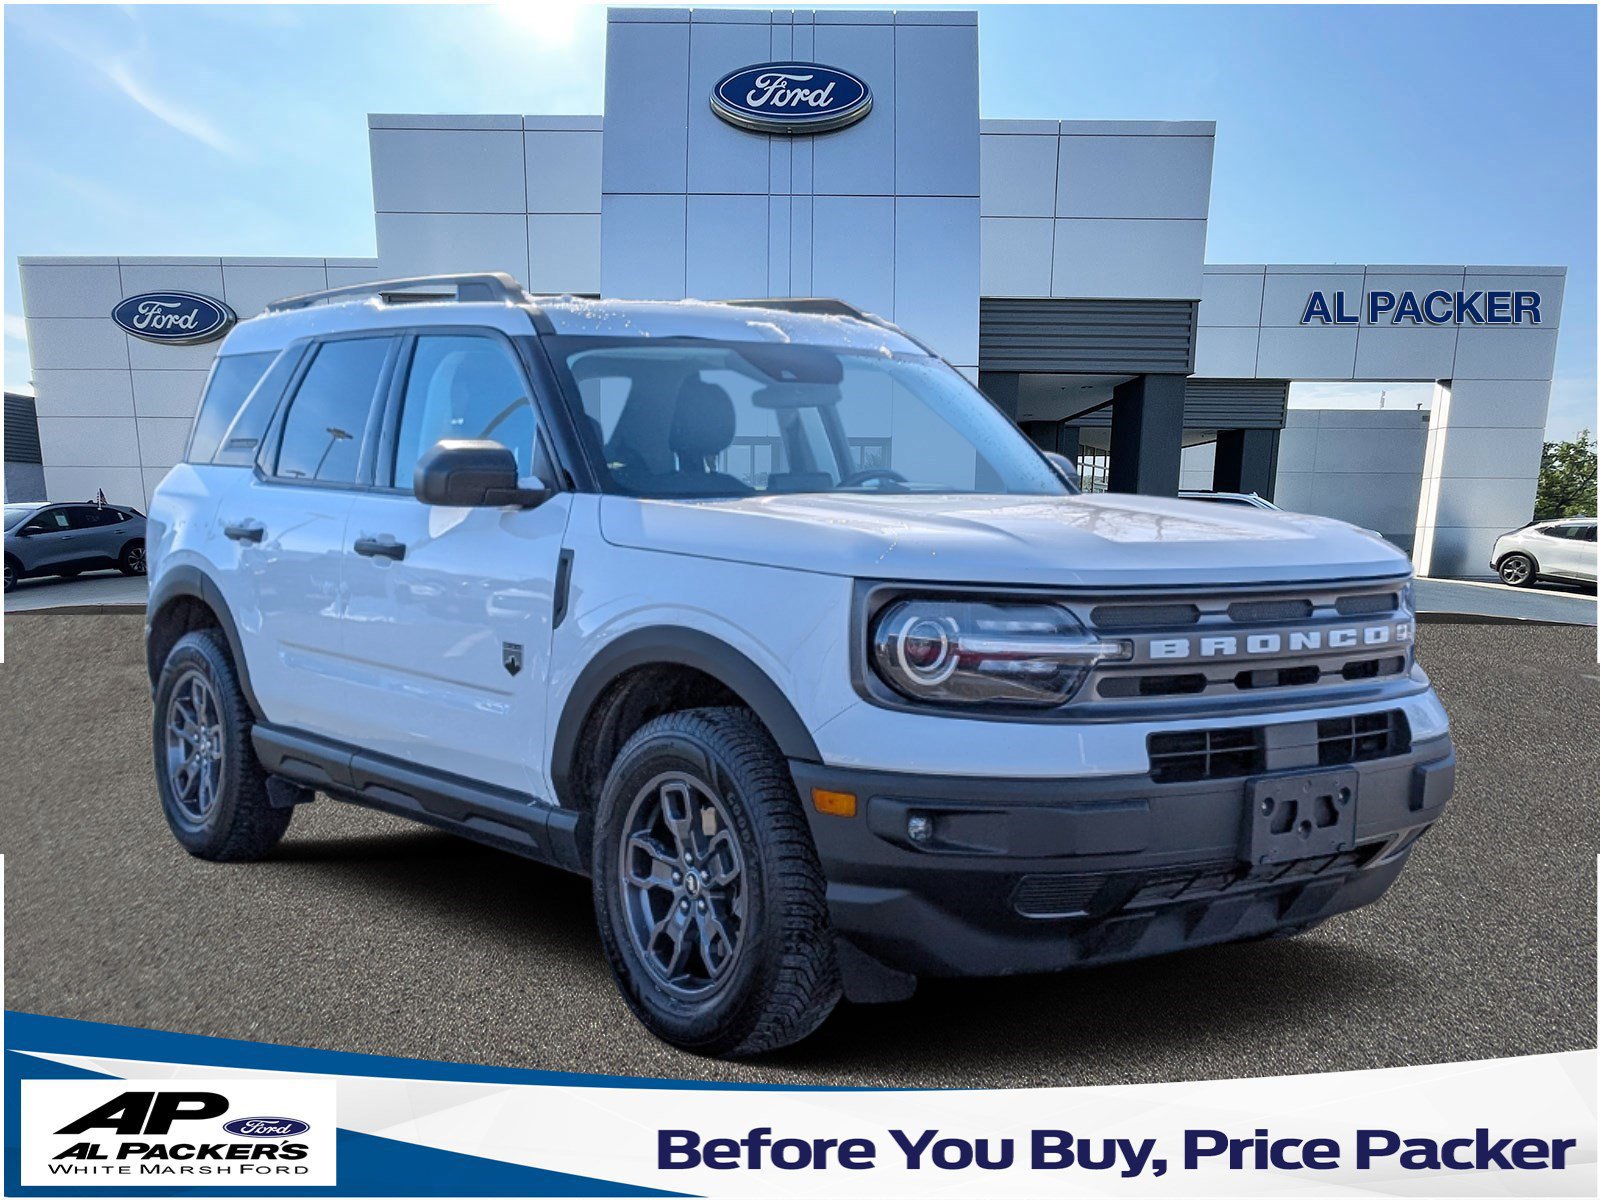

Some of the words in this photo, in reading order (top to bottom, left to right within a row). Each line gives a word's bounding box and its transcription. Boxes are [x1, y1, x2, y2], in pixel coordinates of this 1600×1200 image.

[746, 73, 836, 108] Ford
[133, 300, 199, 330] Ford
[1301, 290, 1360, 325] AL
[1369, 289, 1543, 325] PACKER
[1150, 625, 1390, 659] BRONCO
